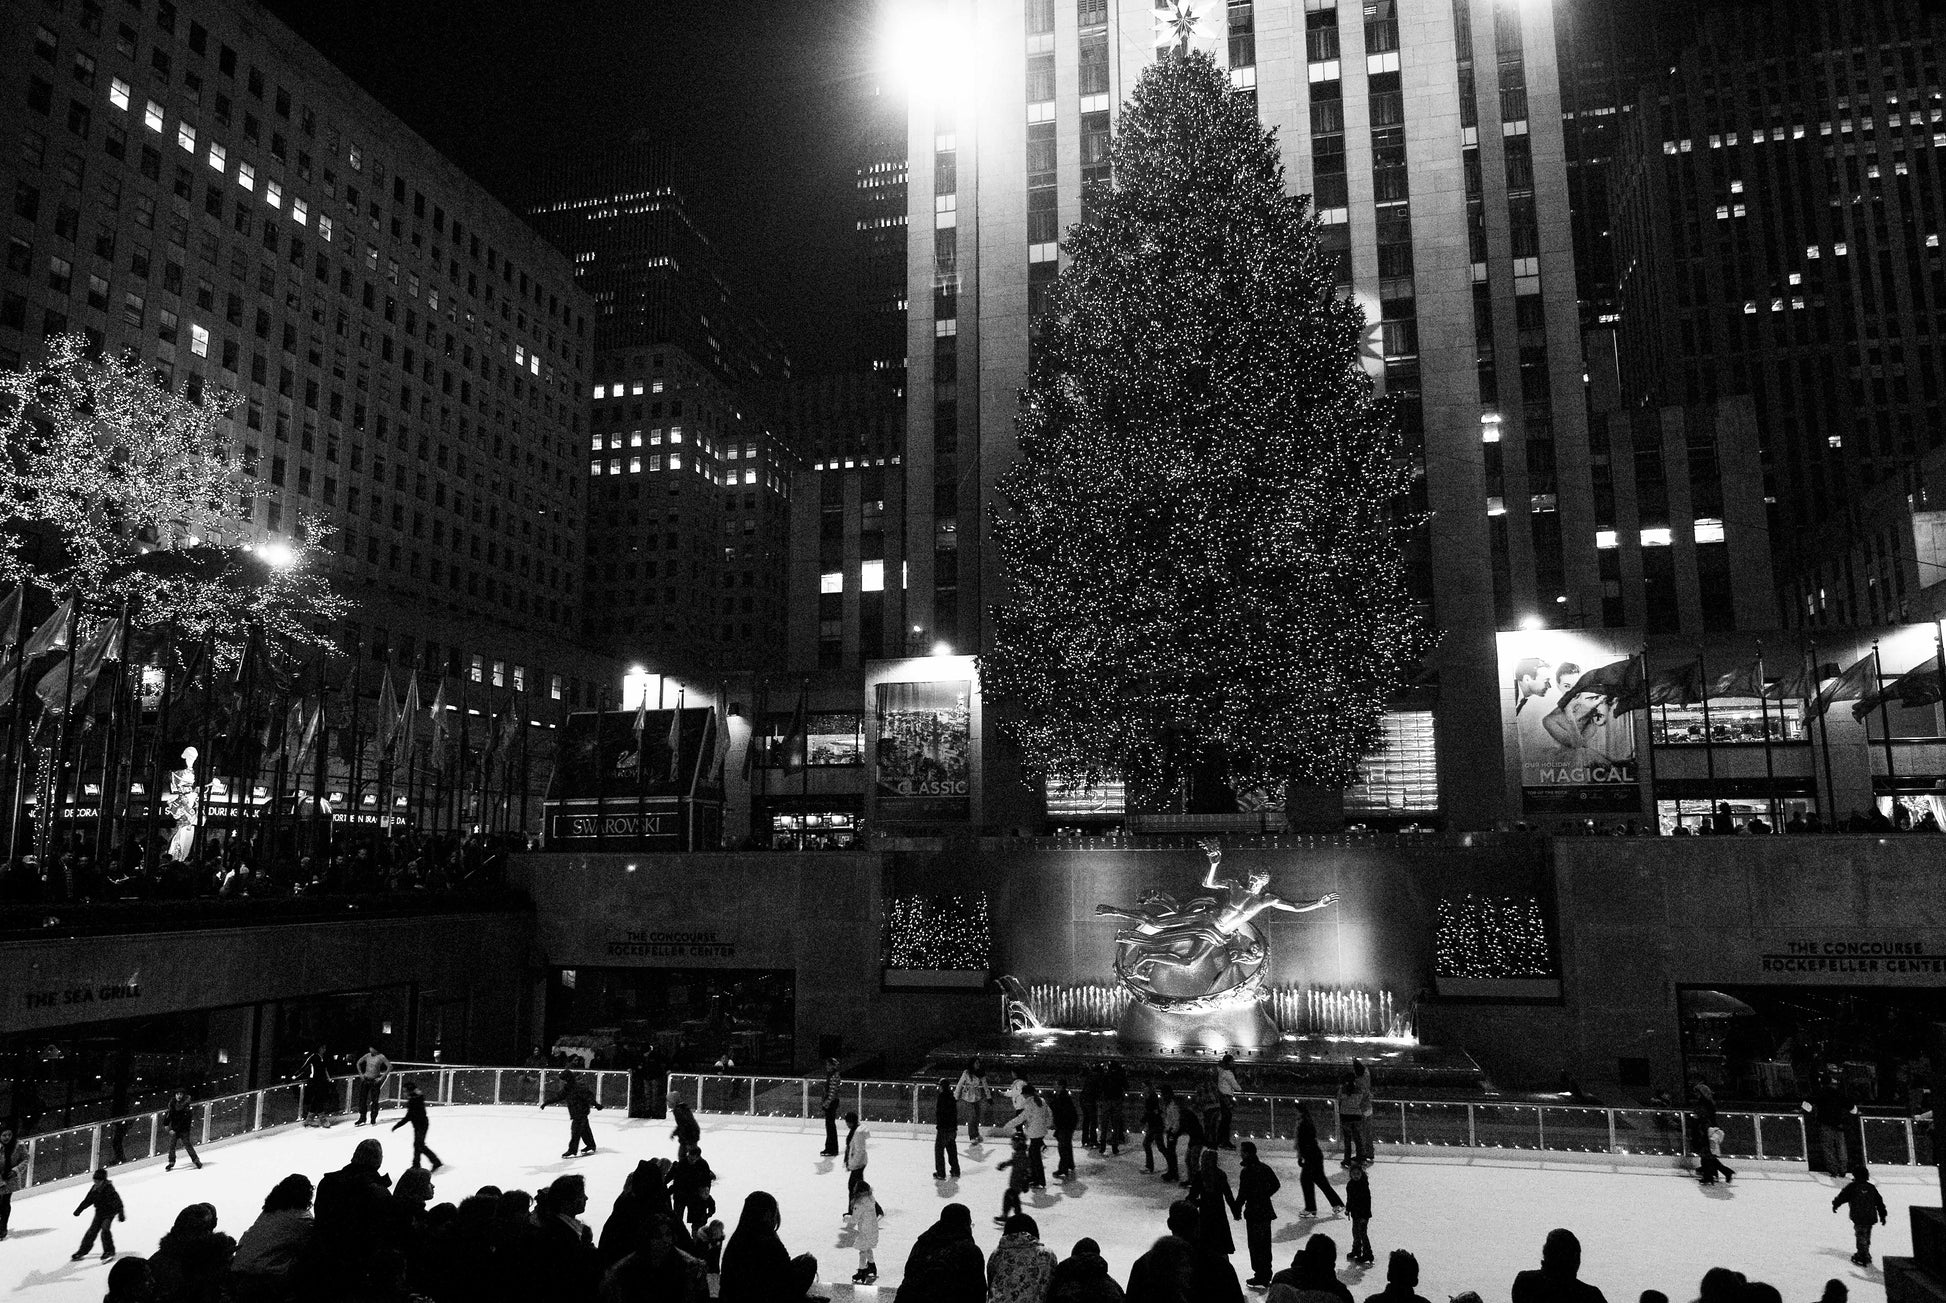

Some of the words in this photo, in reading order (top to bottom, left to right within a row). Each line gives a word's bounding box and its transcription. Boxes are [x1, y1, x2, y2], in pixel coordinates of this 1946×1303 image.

[1539, 765, 1635, 783] MAGICAL
[897, 780, 967, 795] CLASSIC
[627, 931, 646, 942] THE
[649, 931, 717, 942] CONCOURSE
[607, 944, 685, 956] ROCKEFELLER
[690, 945, 735, 957] CENTER
[1788, 942, 1818, 954] THE
[1823, 942, 1924, 955] CONCOURSE
[1762, 959, 1879, 972] ROCKEFELLER
[25, 992, 58, 1009] THE
[63, 988, 94, 1005] SEA
